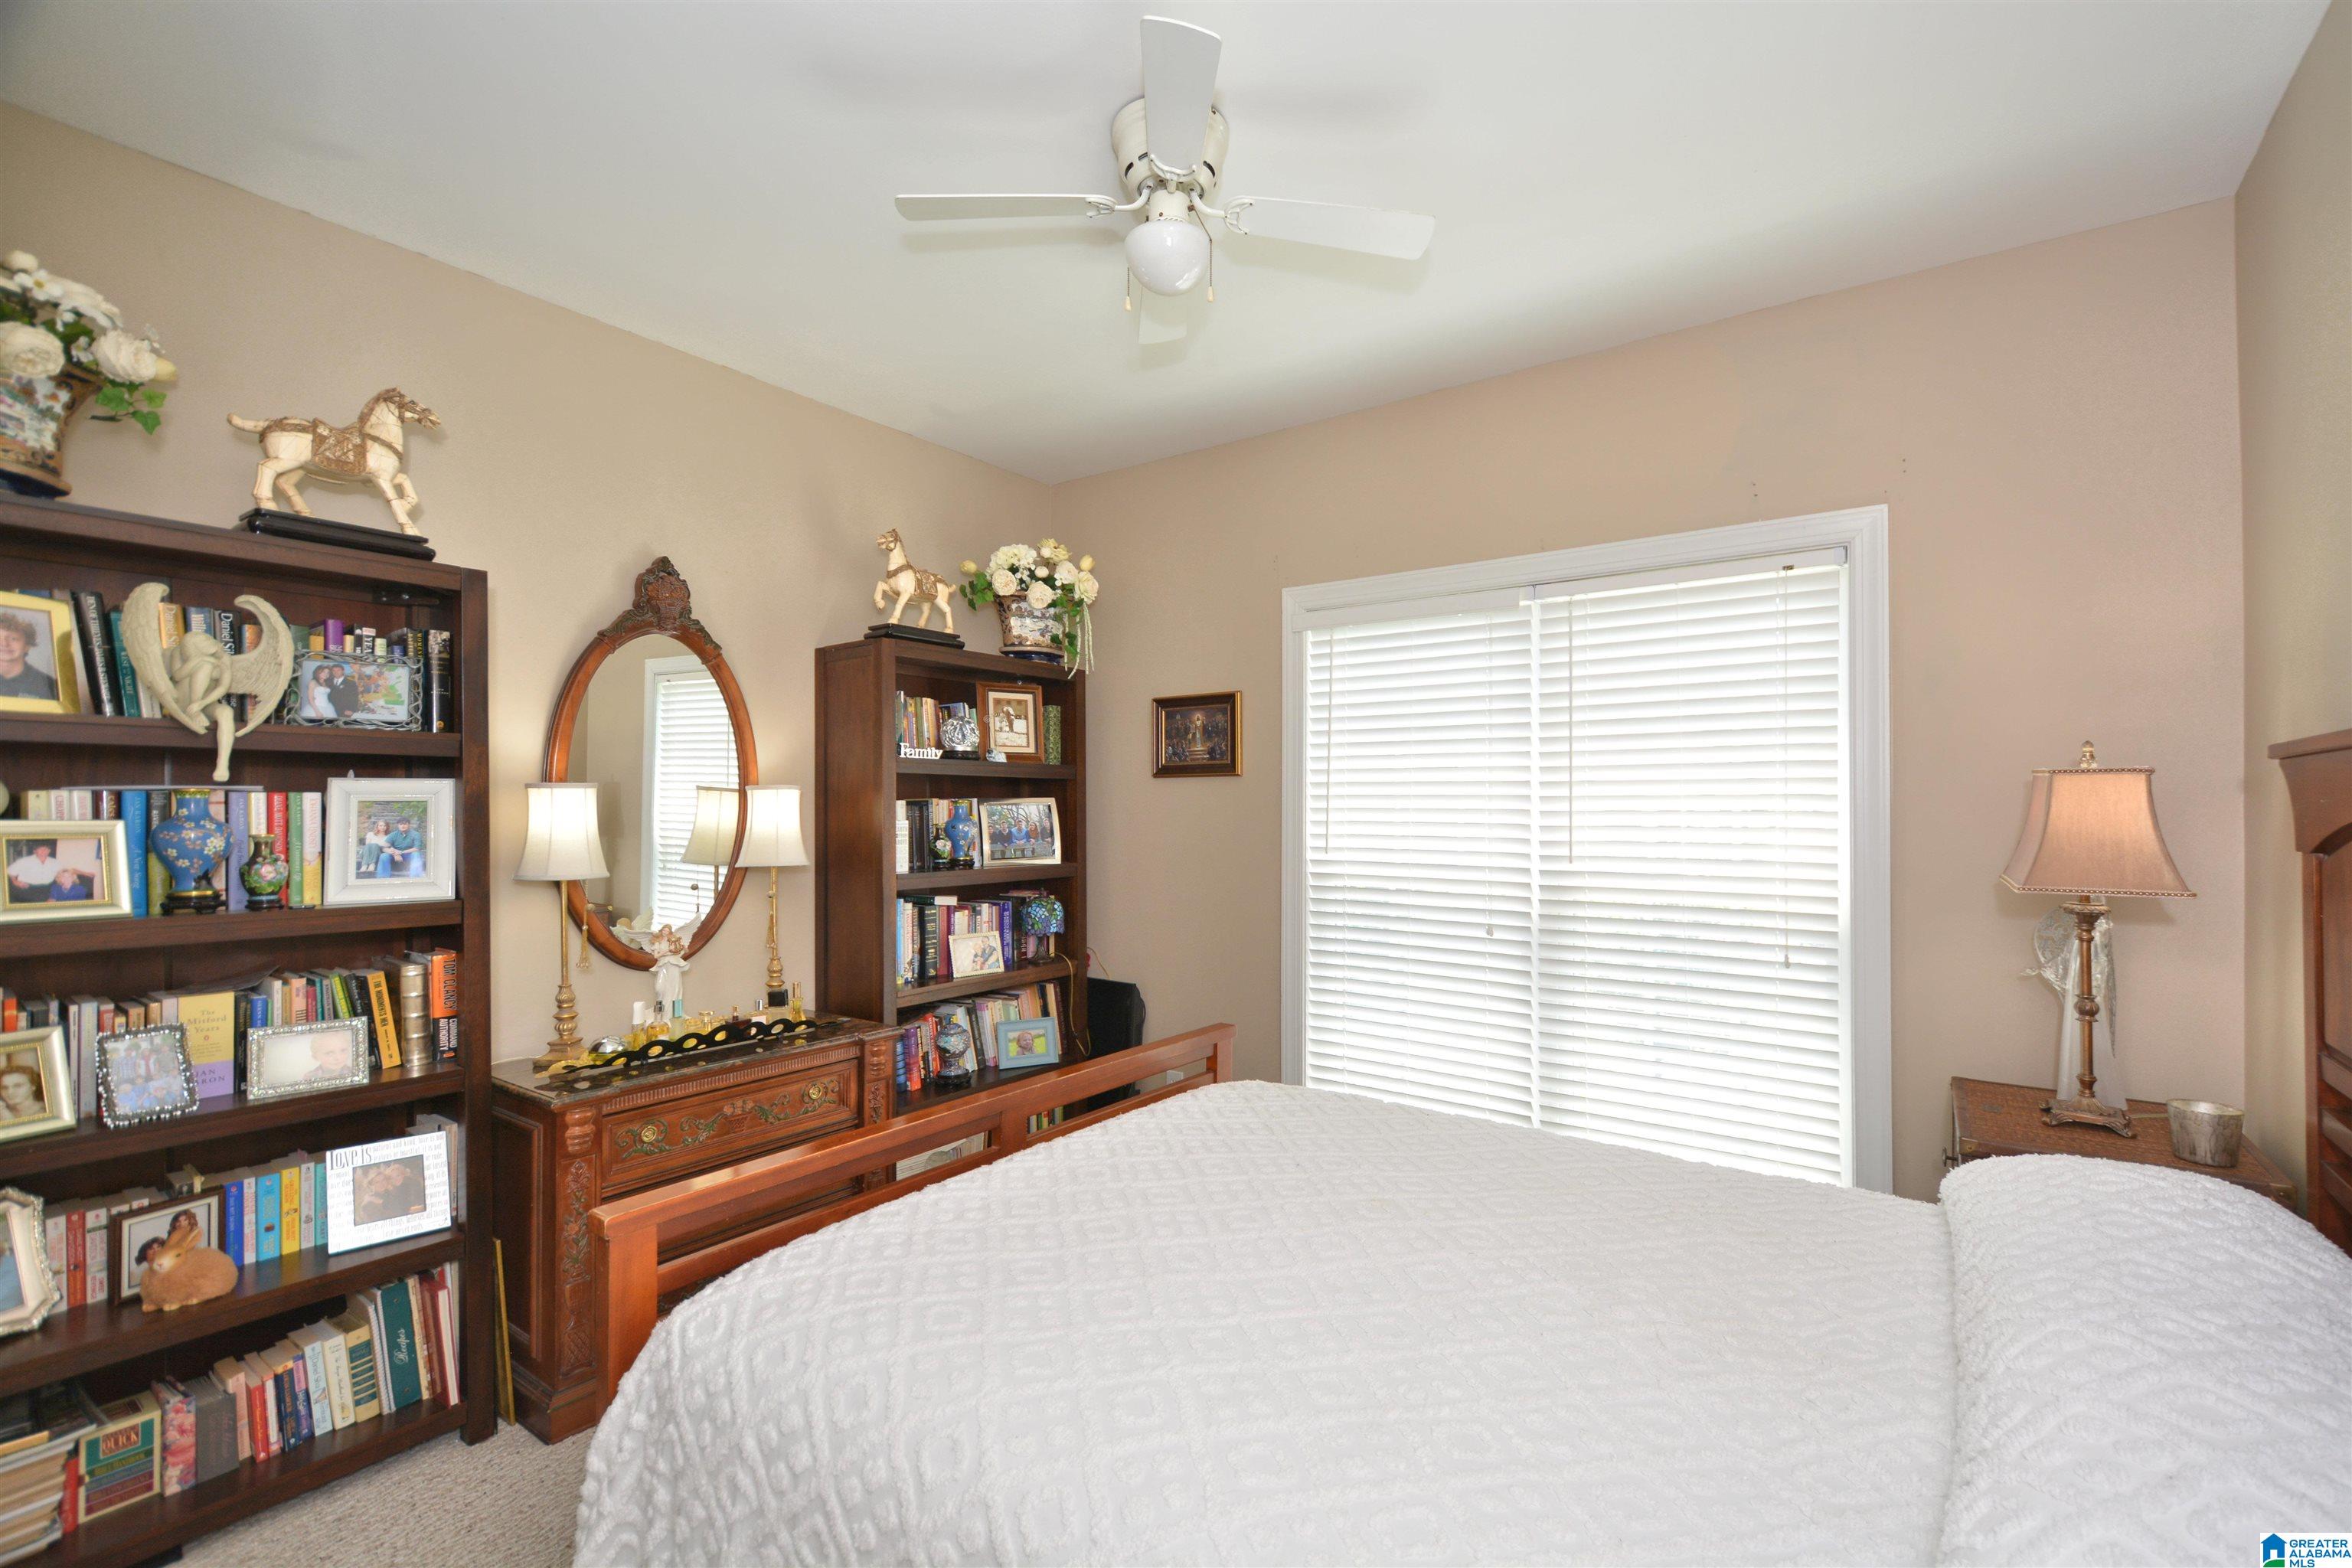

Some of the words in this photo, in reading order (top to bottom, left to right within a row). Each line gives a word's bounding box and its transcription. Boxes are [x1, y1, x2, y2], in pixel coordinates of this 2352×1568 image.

[220, 612, 234, 643] Daniel
[900, 743, 943, 759] Family
[274, 795, 283, 811] DIANE
[274, 812, 283, 825] MOTT
[274, 826, 283, 851] DAVIDSON
[443, 959, 456, 975] TOM
[443, 978, 458, 1011] CLANCY
[439, 1018, 449, 1050] AUTHORITY
[449, 1018, 458, 1048] COMMAND
[195, 1069, 216, 1079] JAN
[195, 1076, 226, 1086] ARON
[361, 1146, 372, 1165] is
[393, 1328, 410, 1365] Recipes
[102, 1430, 138, 1455] QUICK
